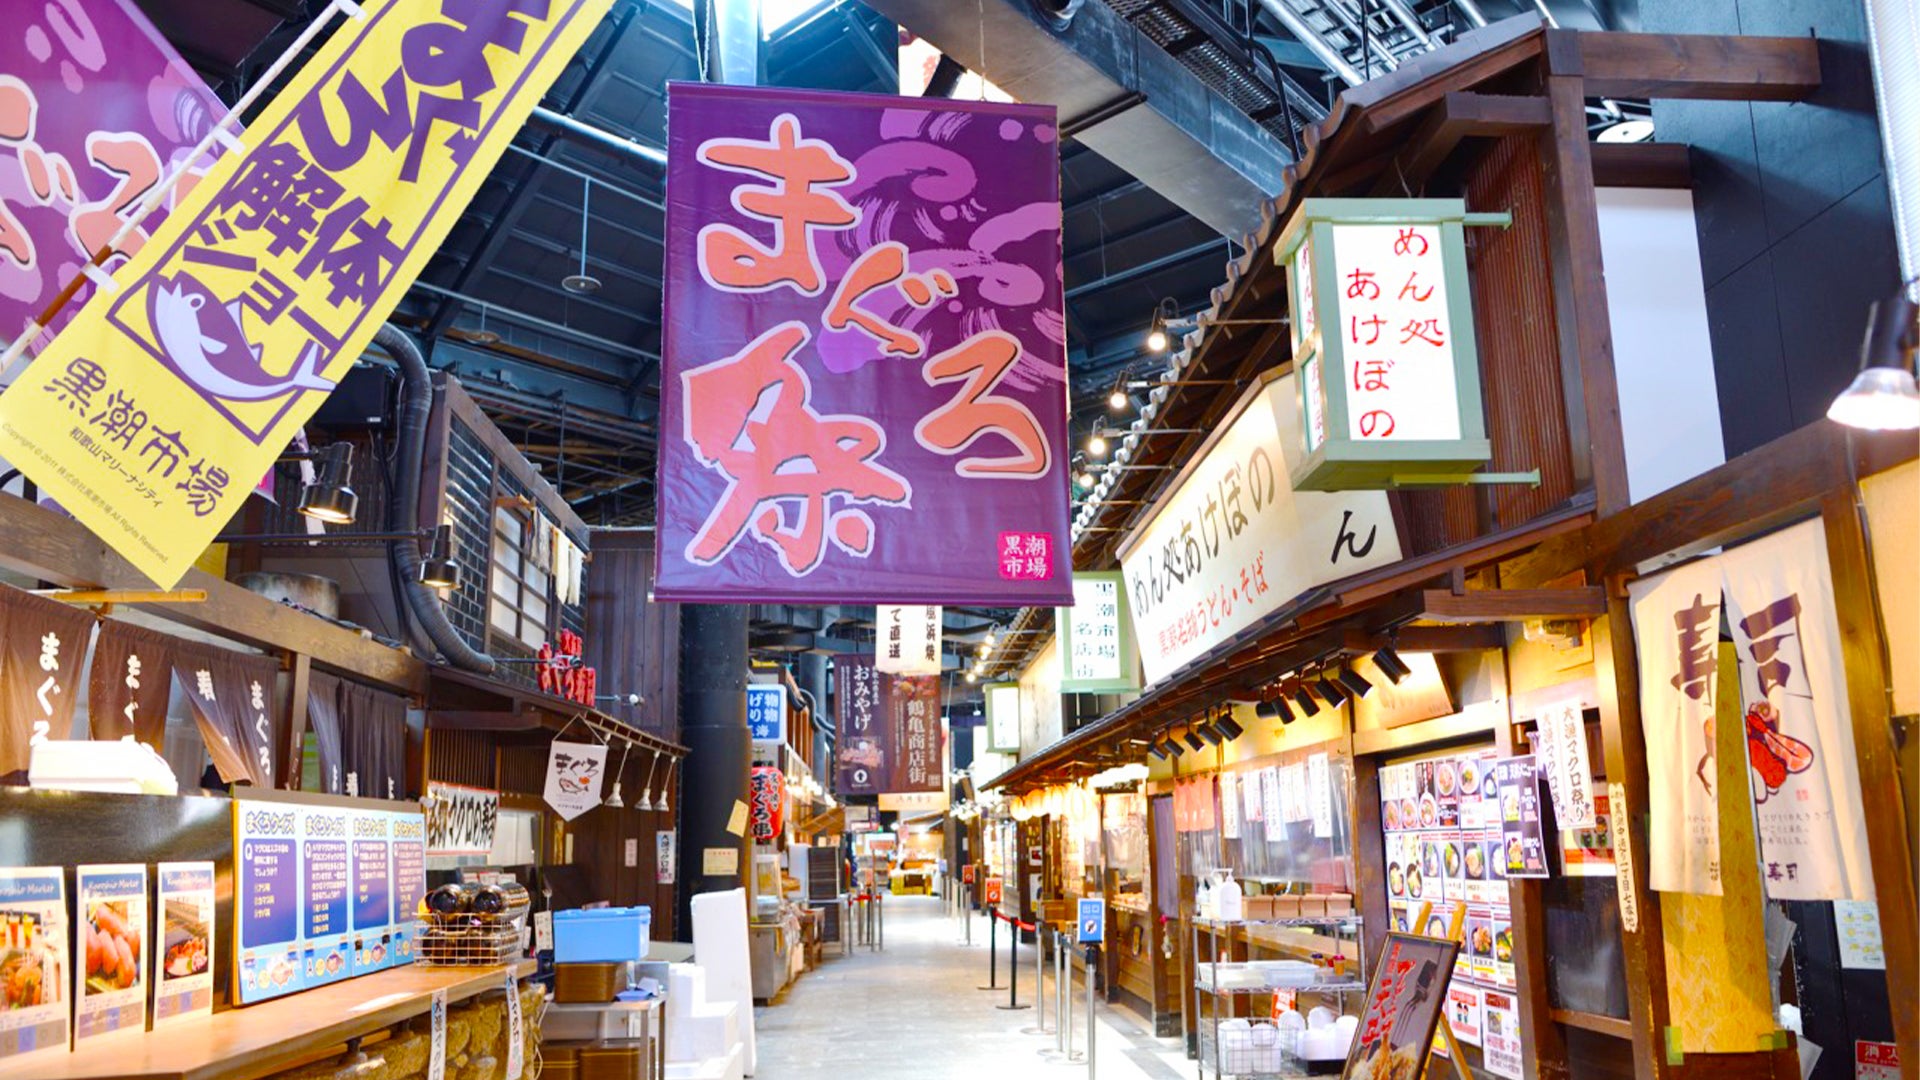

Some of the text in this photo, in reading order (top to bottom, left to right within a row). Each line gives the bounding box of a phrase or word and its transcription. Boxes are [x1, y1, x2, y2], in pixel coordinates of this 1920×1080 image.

[182, 217, 341, 351] ショー
[226, 141, 404, 311] 解体
[1394, 227, 1445, 348] めん処
[697, 112, 1051, 480] まぐろ
[1347, 267, 1396, 438] あけぼの
[43, 356, 230, 518] 黒潮市場
[69, 426, 163, 508] 和歌山マリーナシティ
[681, 321, 912, 576] 祭
[1003, 535, 1046, 555] 黒潮
[1003, 556, 1046, 578] 市場
[1133, 446, 1275, 619] めん処あけぼの
[1331, 510, 1378, 565] ん
[853, 665, 872, 731] おみやげ
[554, 752, 599, 777] まぐろ
